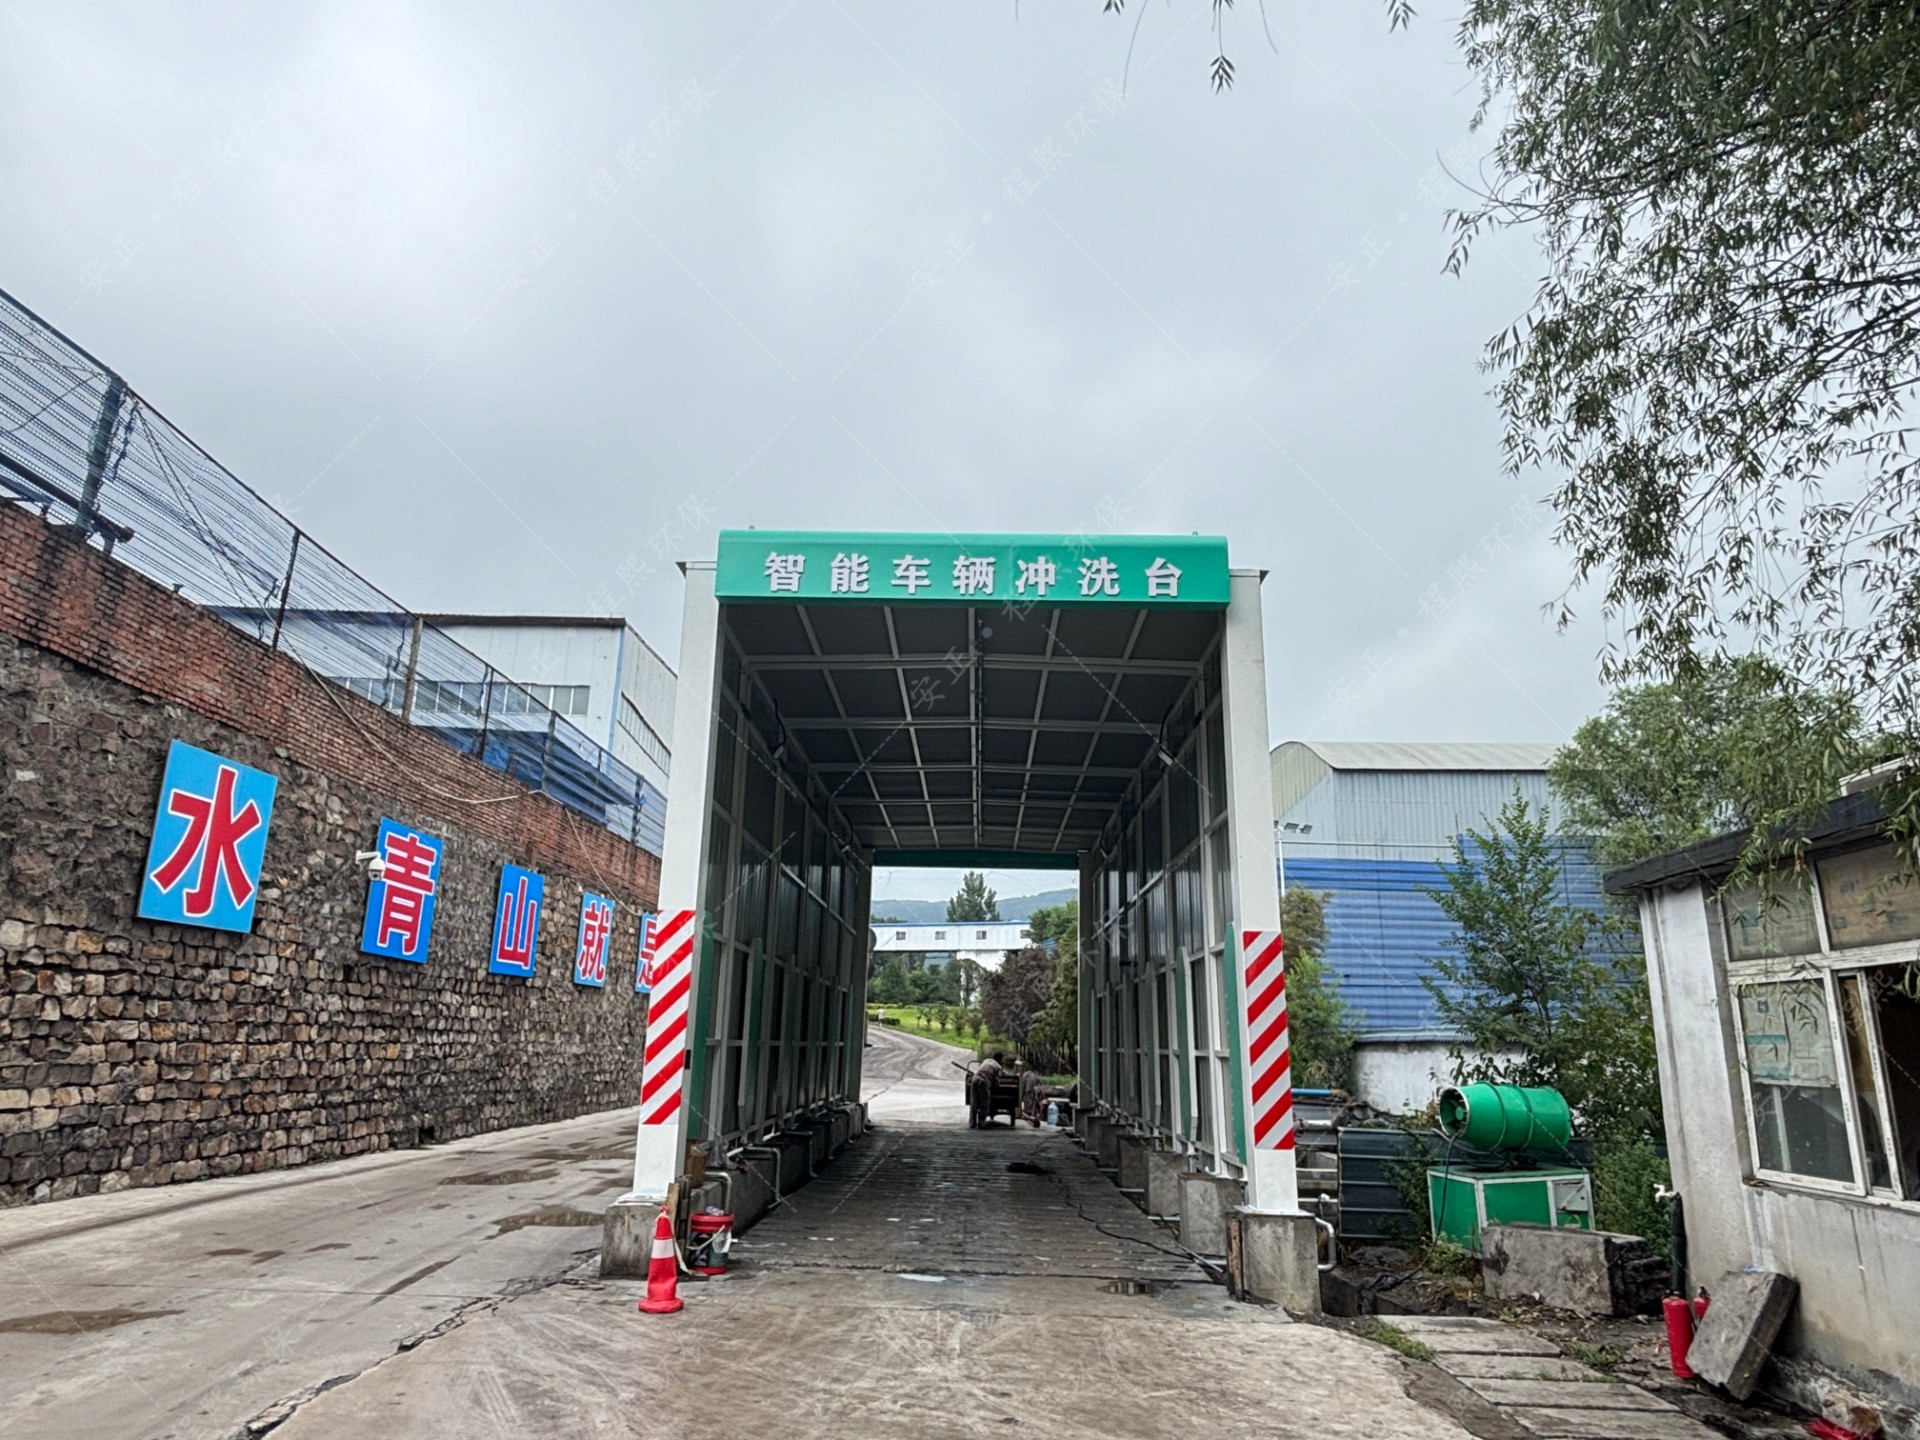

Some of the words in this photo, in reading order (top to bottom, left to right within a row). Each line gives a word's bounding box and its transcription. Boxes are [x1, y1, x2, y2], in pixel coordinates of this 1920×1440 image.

[764, 550, 1184, 598] 智能车辆冲洗台
